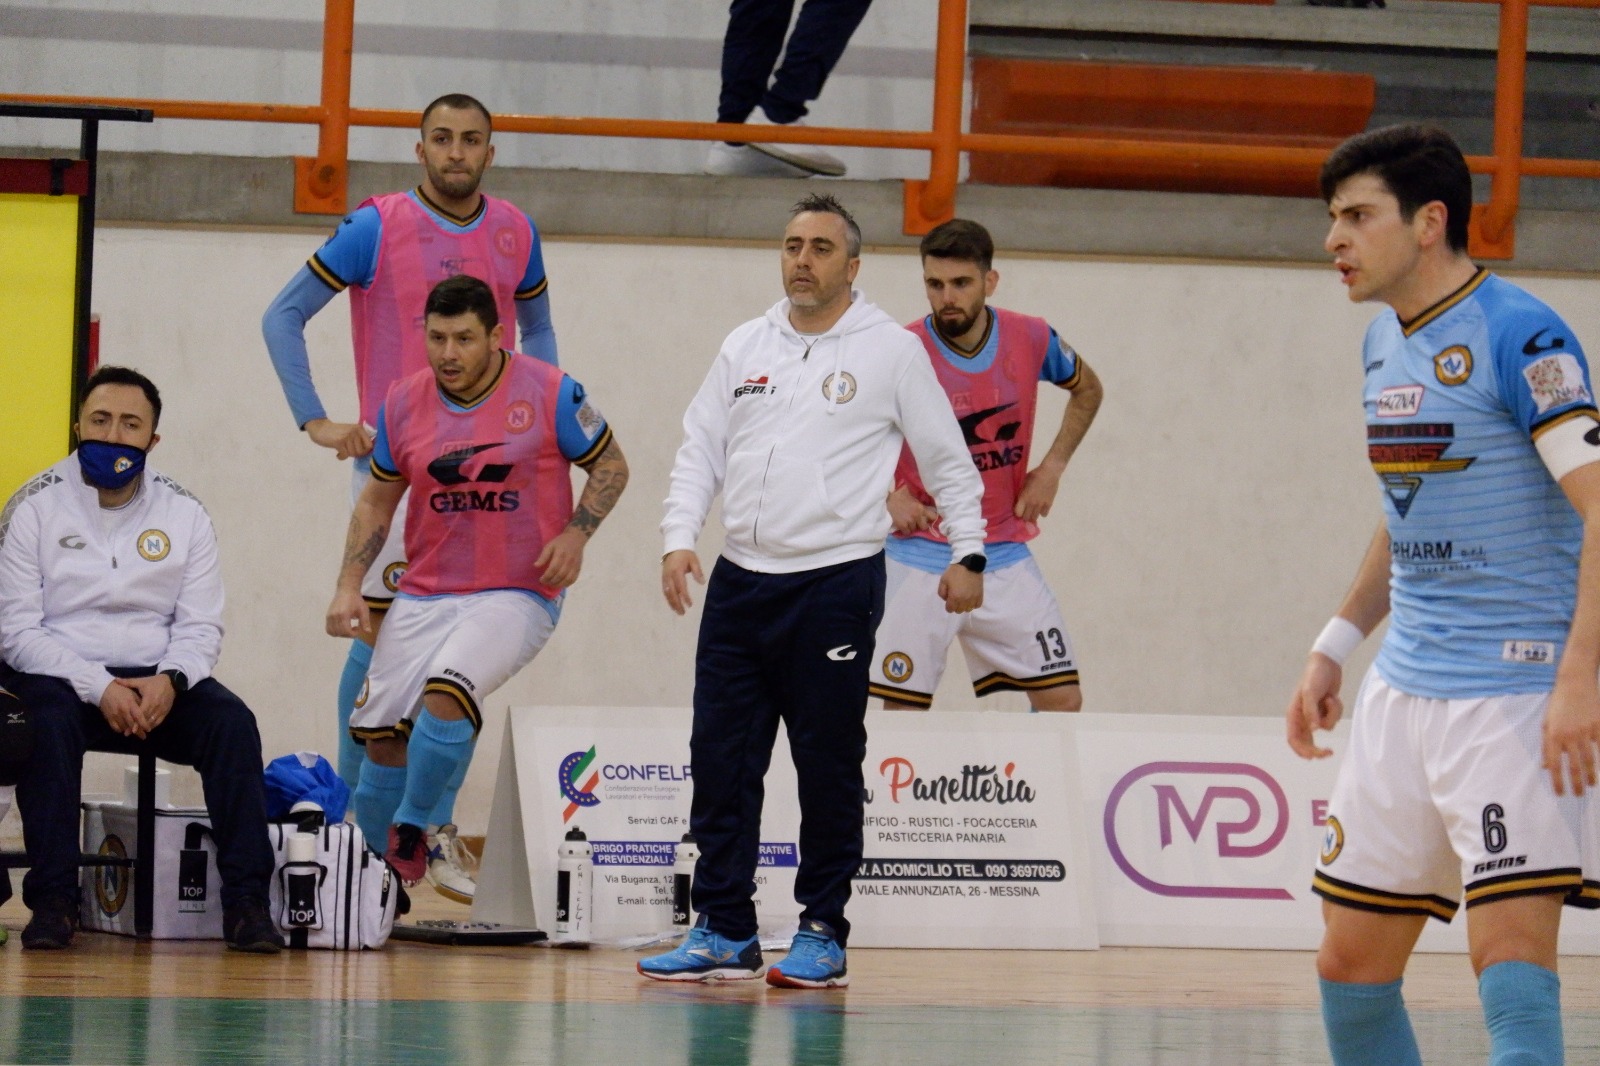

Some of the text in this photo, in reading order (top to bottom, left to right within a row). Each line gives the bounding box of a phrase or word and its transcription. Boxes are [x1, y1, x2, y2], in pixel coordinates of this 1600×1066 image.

[430, 490, 520, 513] GEMS
[146, 538, 161, 553] N
[1036, 627, 1067, 661] 13
[891, 660, 904, 675] N
[1041, 660, 1072, 672] GEMS
[443, 668, 476, 692] GEMS
[880, 757, 1036, 805] Panetteria
[627, 816, 658, 825] Servizi
[660, 816, 679, 825] CAF
[864, 817, 899, 827] IFICIO
[909, 818, 954, 827] RUSTICI
[963, 818, 1037, 828] FOCACCERIA
[1483, 803, 1507, 853] 6
[878, 833, 1006, 843] PASTICCERIA PANARIA
[625, 845, 672, 854] PRATICHE
[598, 855, 668, 864] PREVIDENZIALI
[1473, 855, 1527, 875] GEMS
[871, 864, 882, 876] A
[883, 864, 952, 877] DOMICILIO
[953, 864, 983, 877] TEL.
[985, 864, 1008, 878] 090
[1010, 865, 1061, 878] 3697056
[605, 875, 619, 883] Via
[621, 875, 661, 885] Buganza,
[183, 886, 203, 897] TOP
[654, 886, 669, 894] Tel.
[856, 884, 890, 895] VIALE
[892, 885, 966, 898] ANNUNZIATA,
[968, 886, 981, 896] 26
[990, 886, 1040, 897] MESSINA
[617, 896, 647, 905] E-mail:
[290, 909, 315, 922] TOP
